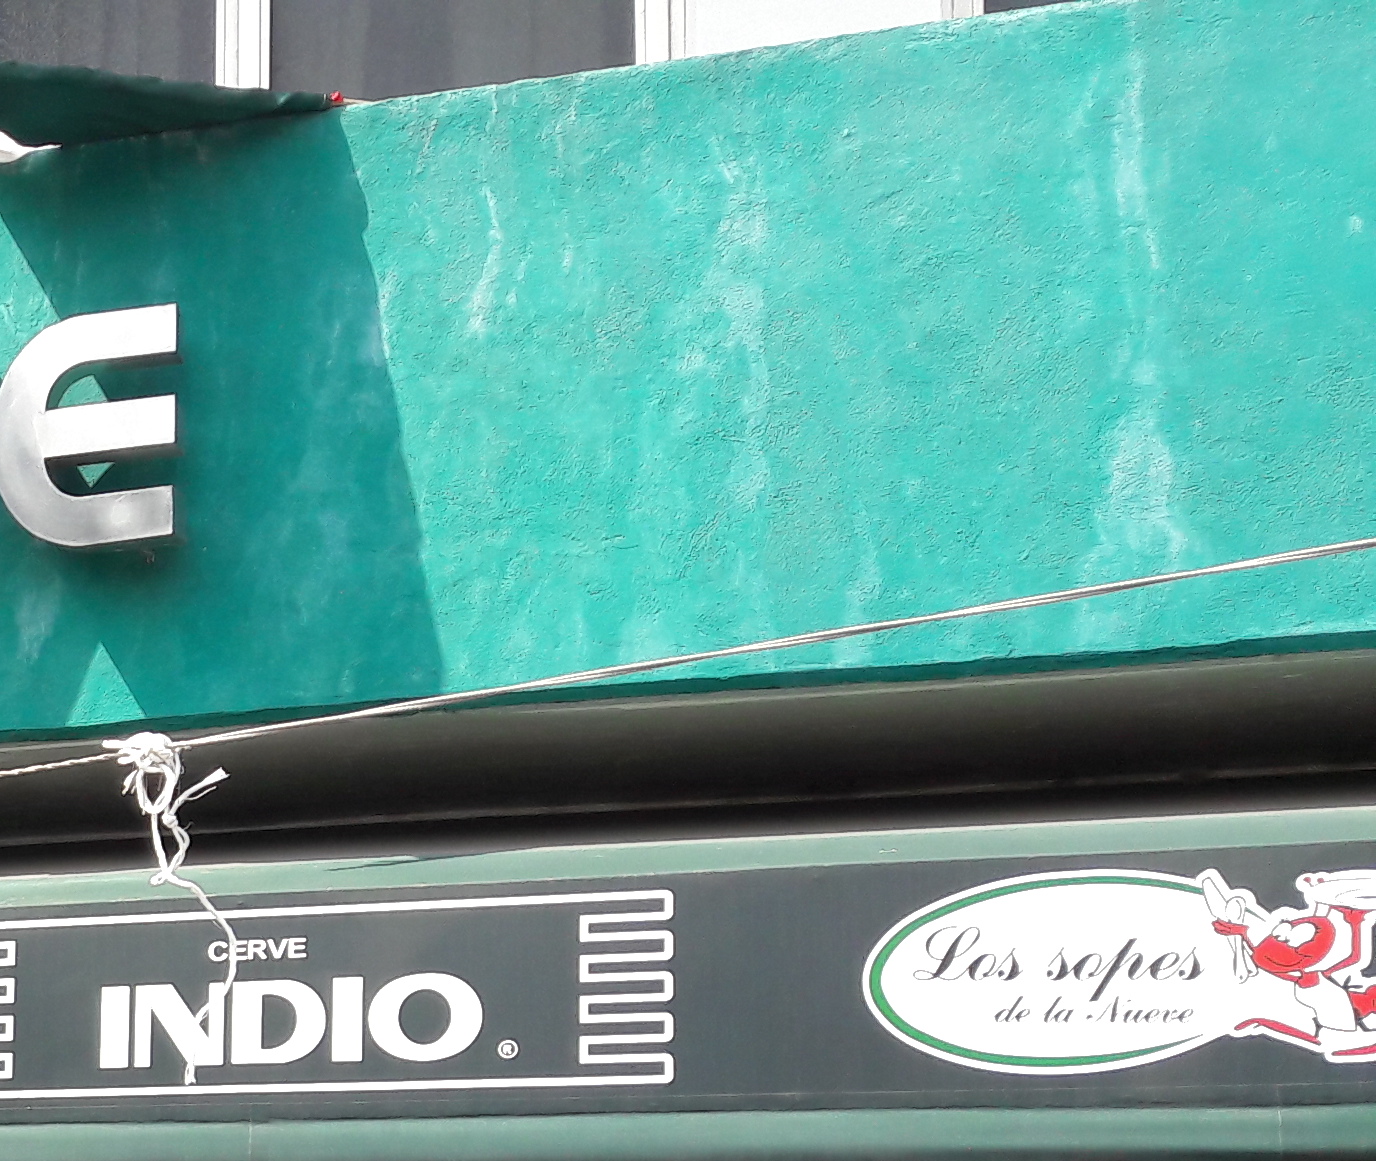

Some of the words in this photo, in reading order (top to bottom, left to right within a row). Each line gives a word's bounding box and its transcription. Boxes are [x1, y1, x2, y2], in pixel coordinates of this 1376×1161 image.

[207, 937, 308, 962] CERVE
[913, 926, 1023, 981] Los
[1047, 938, 1205, 1002] sopes
[99, 972, 484, 1068] INDIO
[994, 996, 1031, 1024] de
[1043, 996, 1074, 1024] la
[1086, 996, 1194, 1024] Nueve
